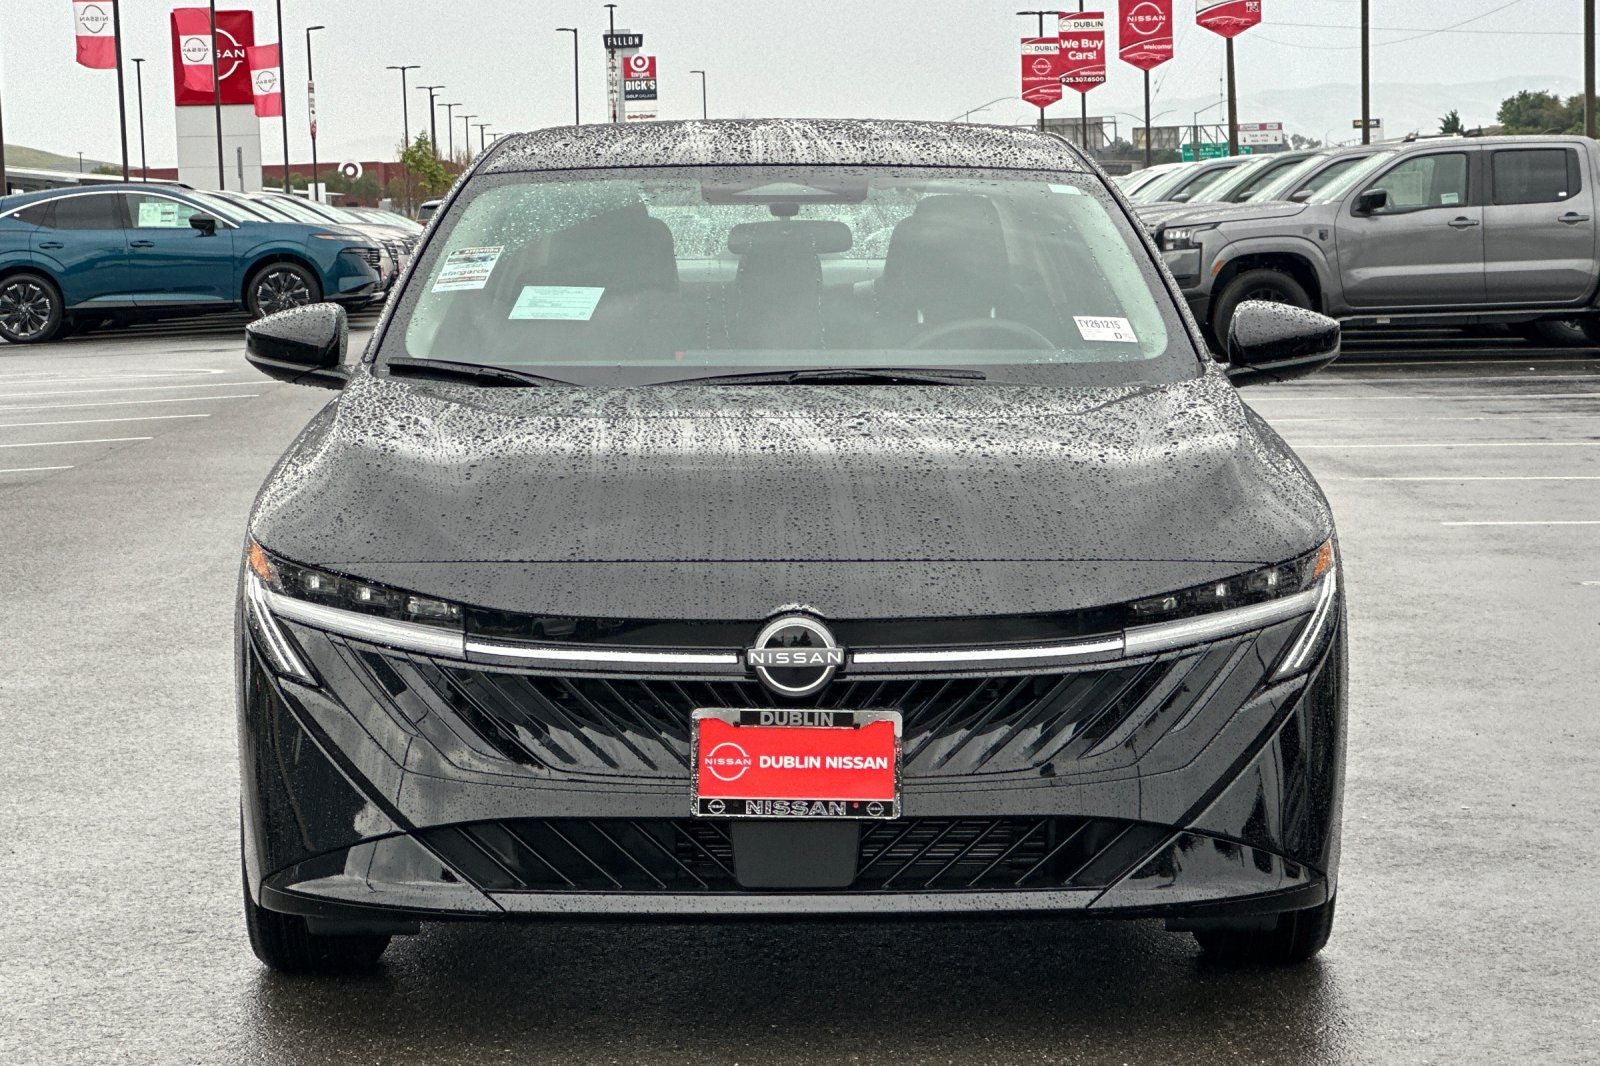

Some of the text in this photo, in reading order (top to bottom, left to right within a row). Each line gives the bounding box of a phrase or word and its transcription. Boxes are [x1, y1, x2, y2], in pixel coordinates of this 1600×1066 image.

[1061, 39, 1103, 50] We Buy
[216, 50, 245, 58] SAN
[1068, 51, 1096, 60] Cars!
[626, 80, 655, 90] DICK'S
[750, 651, 842, 664] NISSAN
[759, 711, 834, 727] DUBLIN
[704, 757, 752, 766] NISSAN
[759, 755, 888, 770] DUBLIN NISSAN
[745, 800, 847, 816] NISSAN
